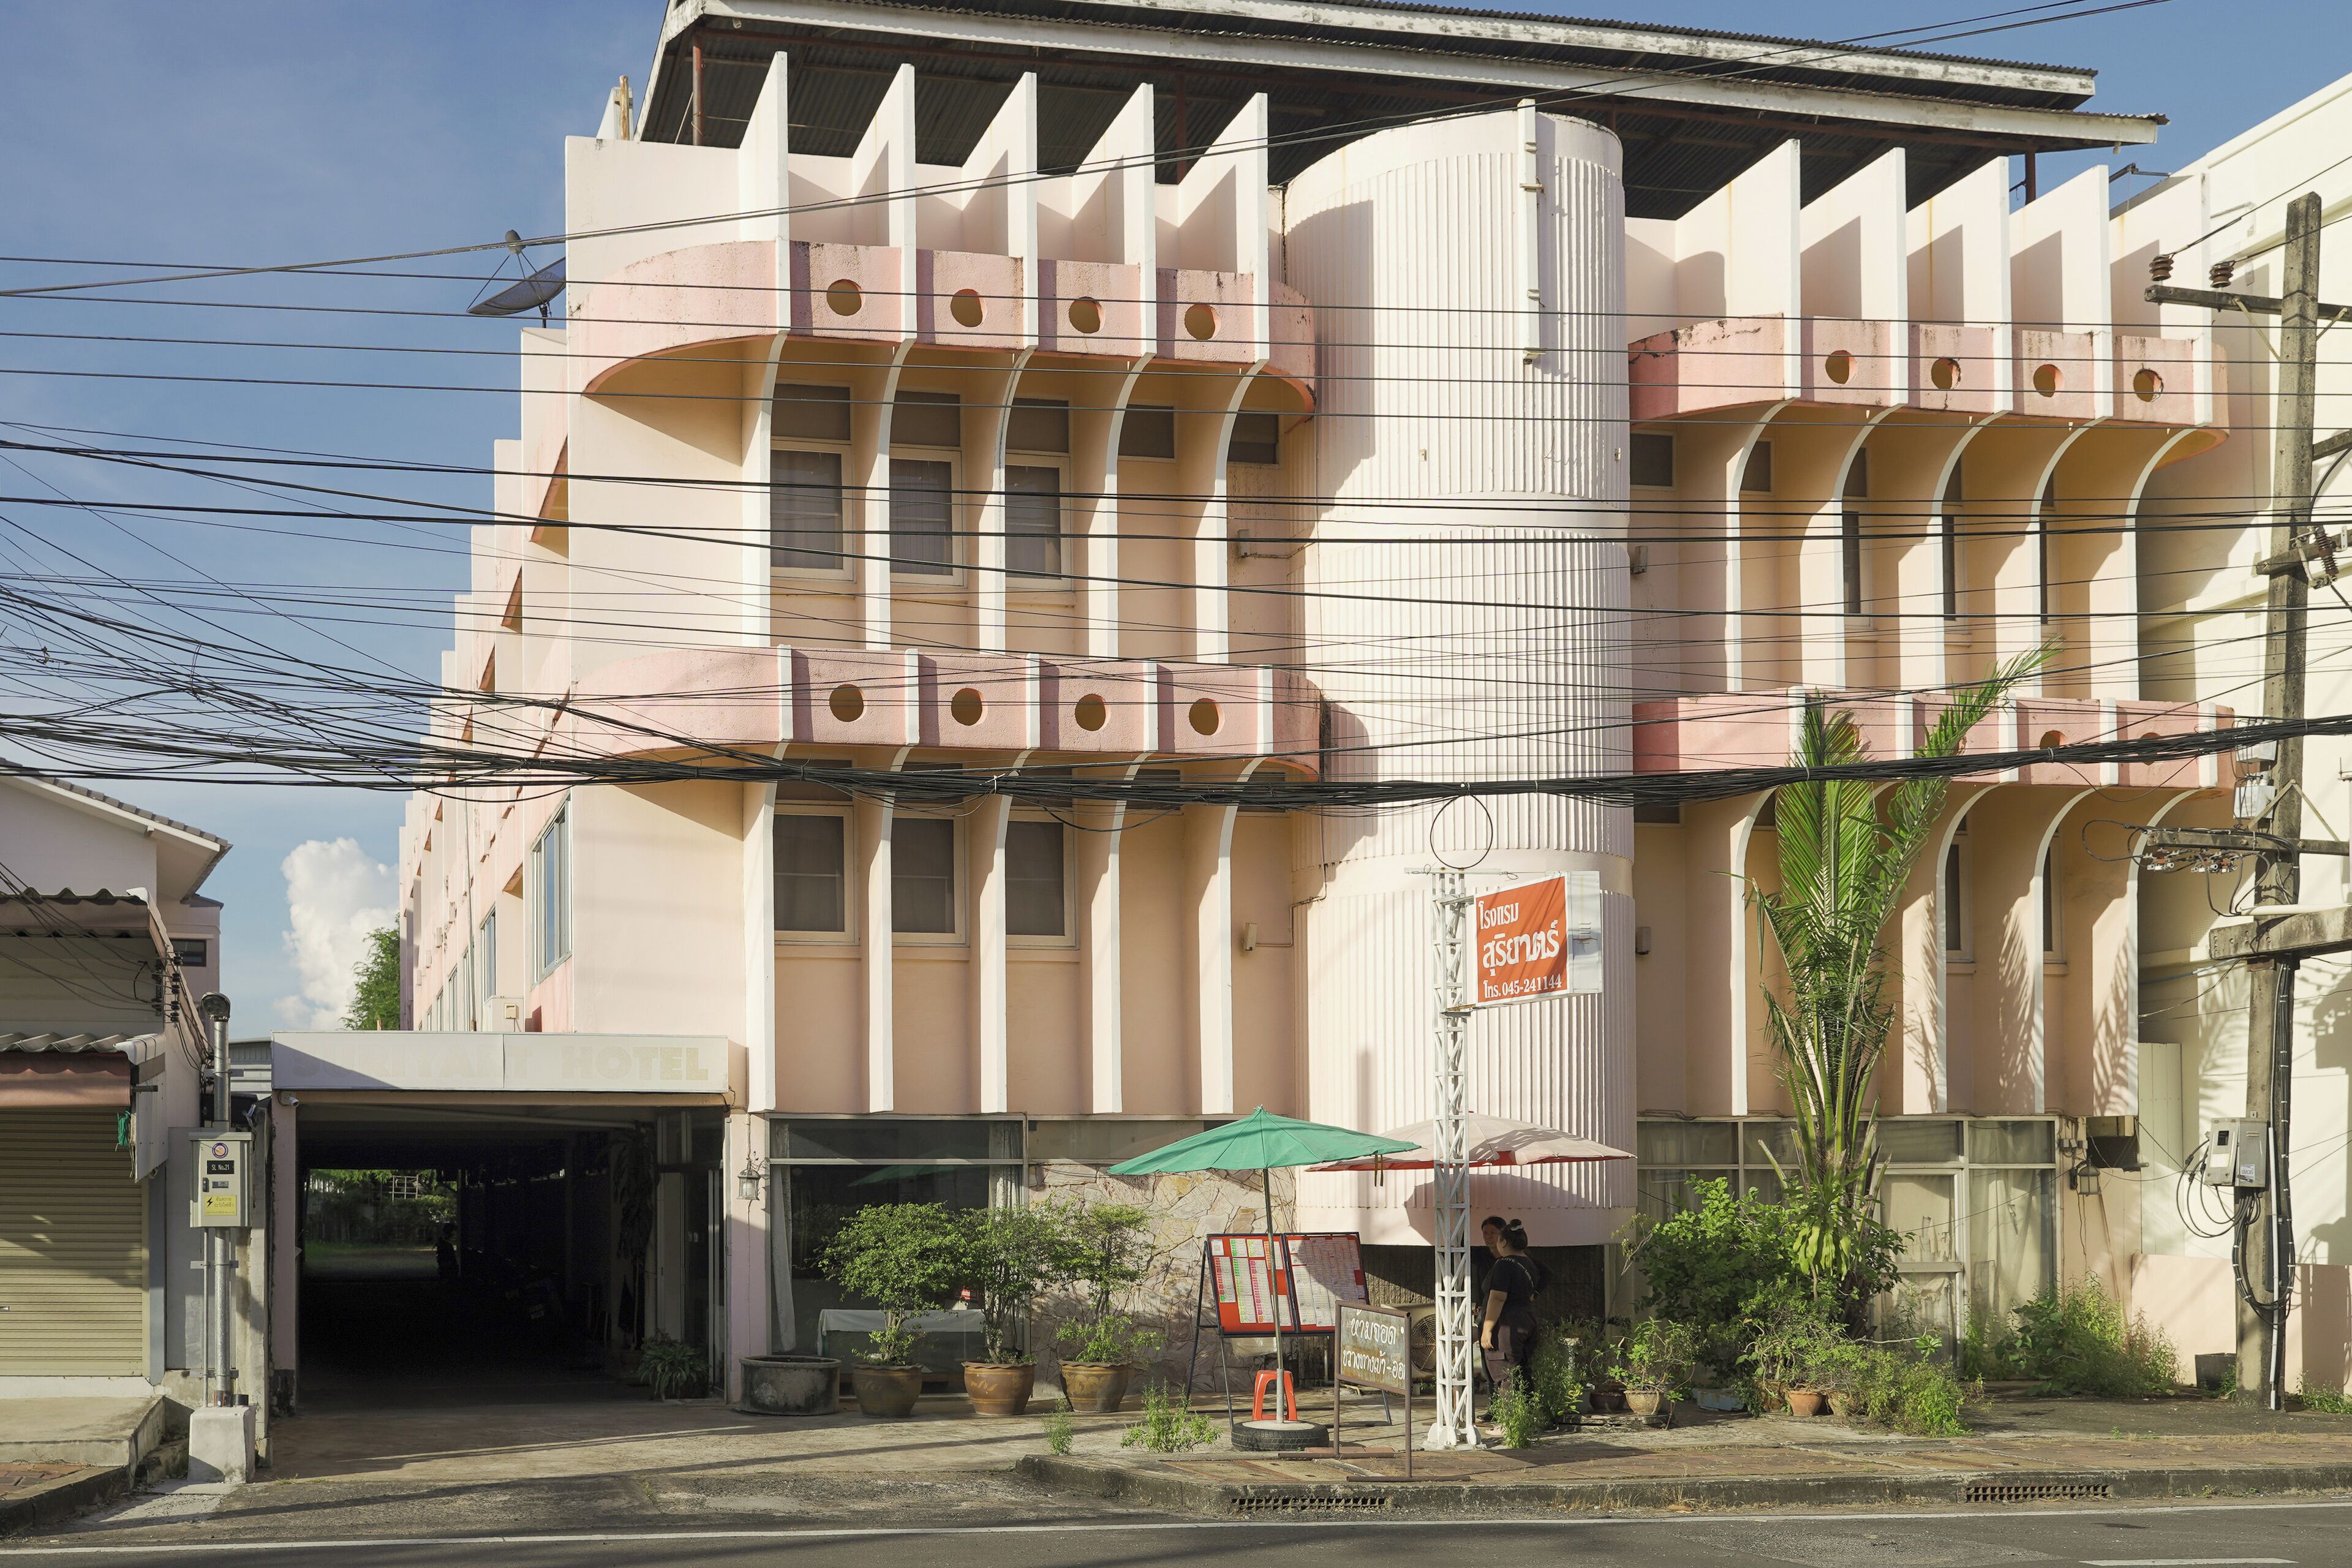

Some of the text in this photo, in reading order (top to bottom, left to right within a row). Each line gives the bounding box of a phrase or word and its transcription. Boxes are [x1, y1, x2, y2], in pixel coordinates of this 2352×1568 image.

[1478, 900, 1520, 930] โรงแรม
[1482, 919, 1560, 977] สุริยาตร์
[1502, 973, 1562, 995] 045-241144
[562, 1045, 709, 1081] HOTEL
